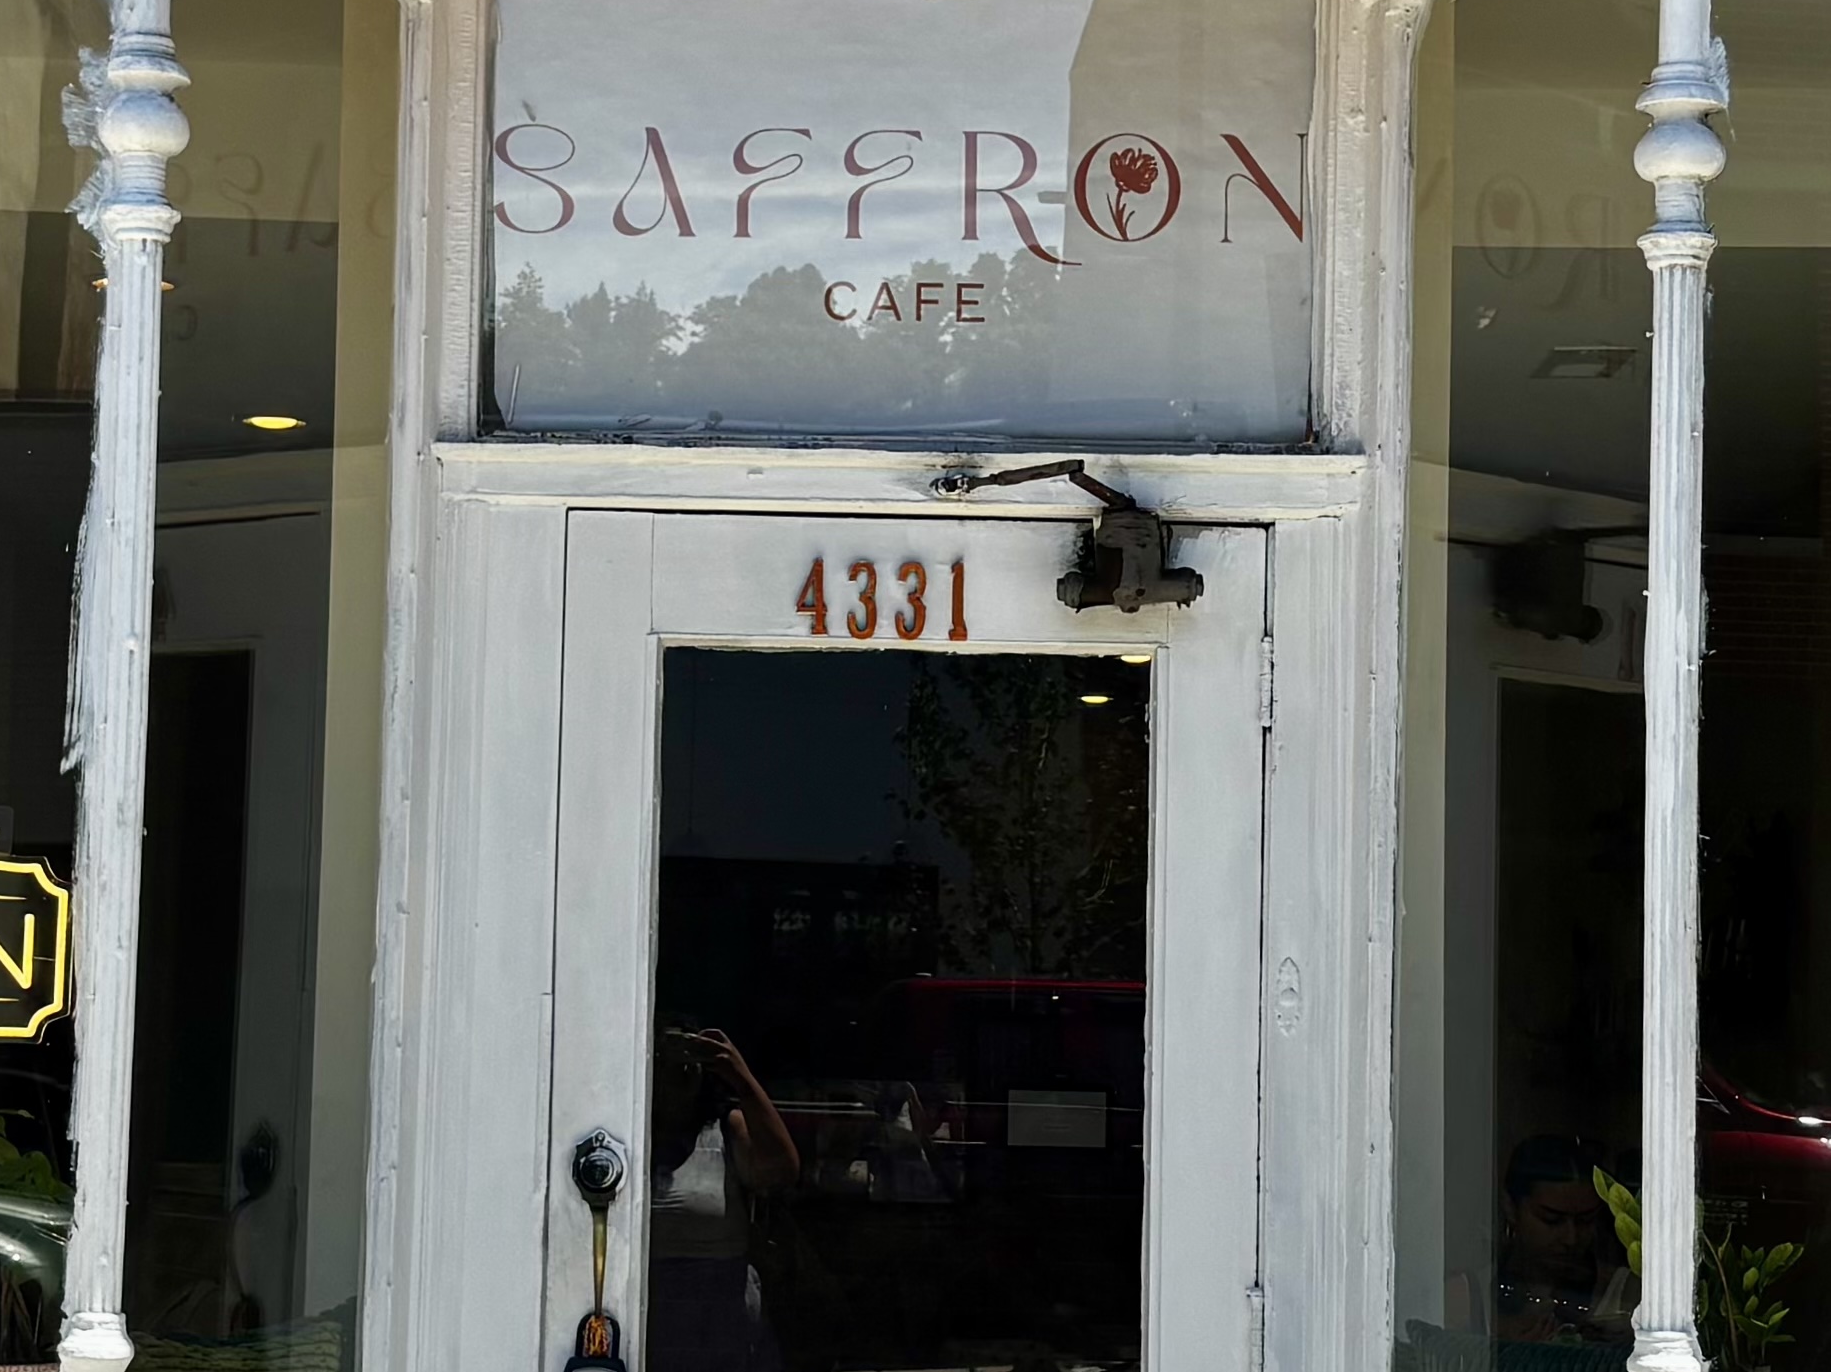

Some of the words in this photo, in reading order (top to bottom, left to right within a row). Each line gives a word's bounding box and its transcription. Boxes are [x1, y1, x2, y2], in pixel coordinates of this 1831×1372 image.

[494, 122, 1308, 267] SAFFRON
[823, 280, 986, 324] CAFE
[795, 557, 969, 642] 4331
